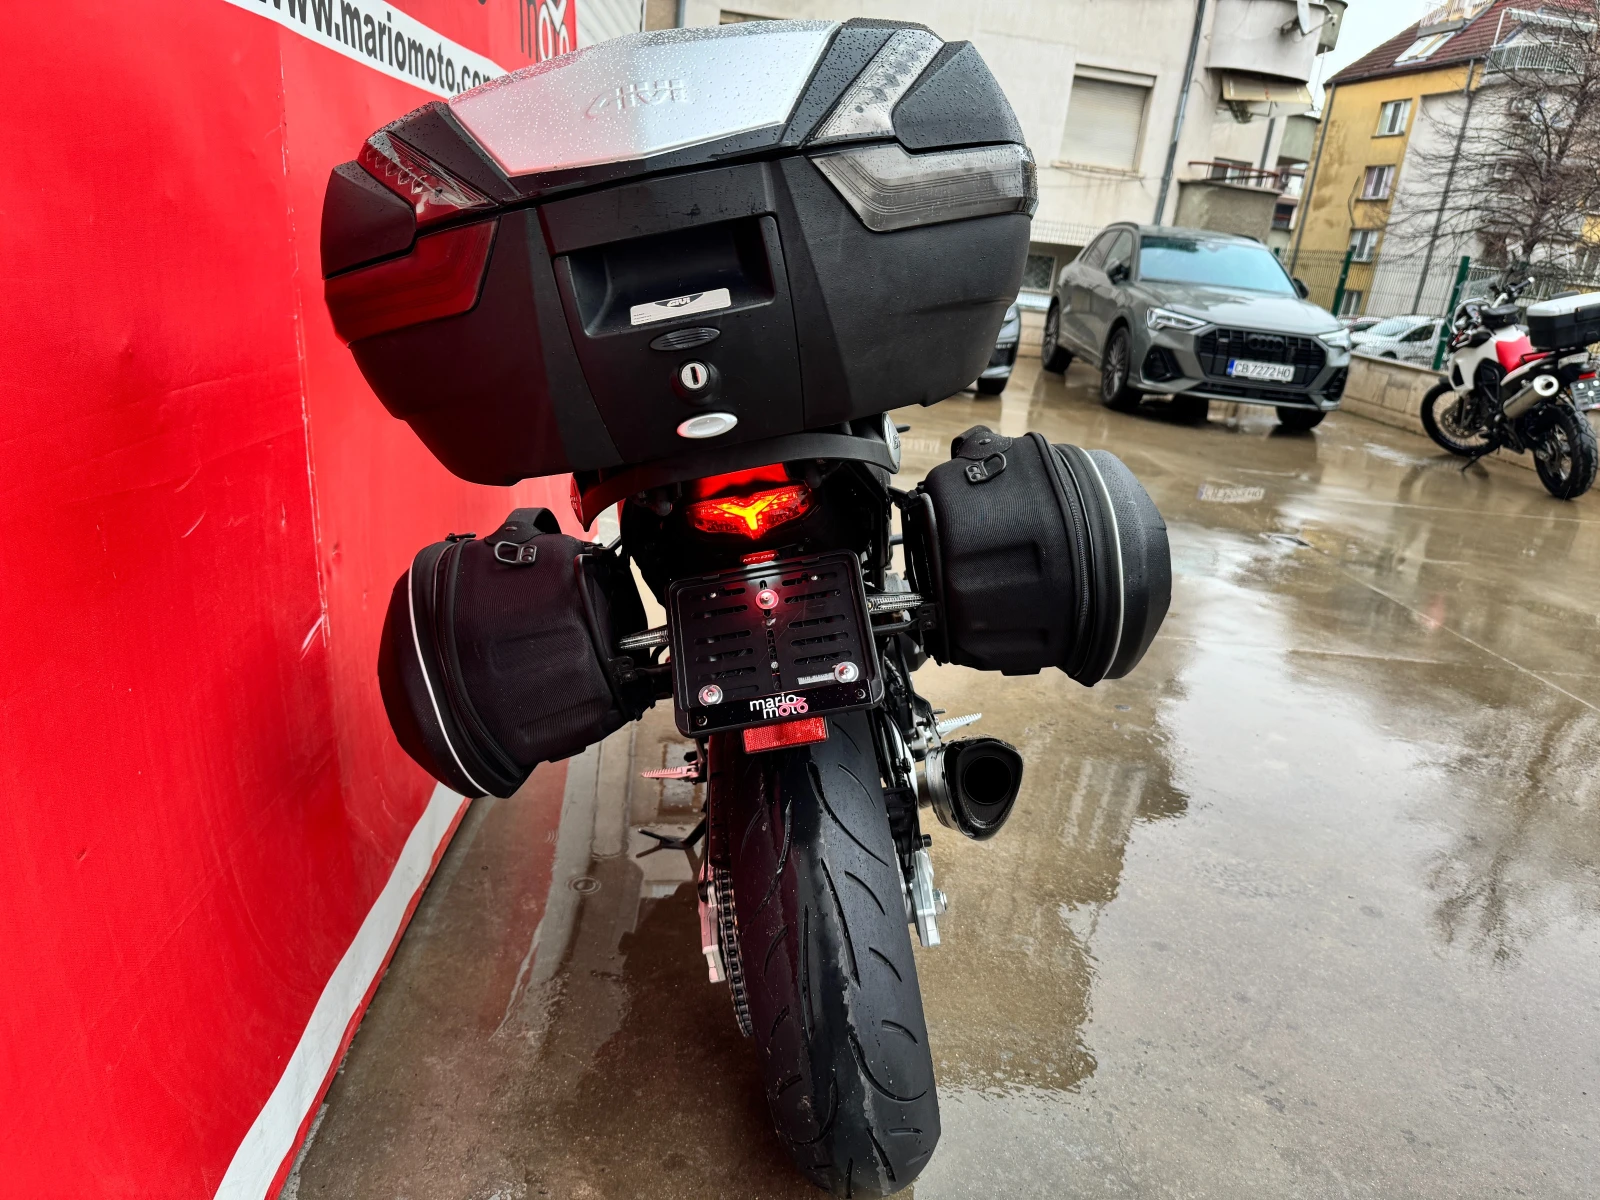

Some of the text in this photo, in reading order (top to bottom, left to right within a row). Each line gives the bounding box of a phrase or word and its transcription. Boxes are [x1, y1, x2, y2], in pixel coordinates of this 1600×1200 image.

[666, 296, 691, 307] GIVI
[1234, 363, 1249, 373] CB
[1250, 364, 1276, 376] 7272
[750, 693, 797, 711] mario
[763, 702, 809, 719] moto
